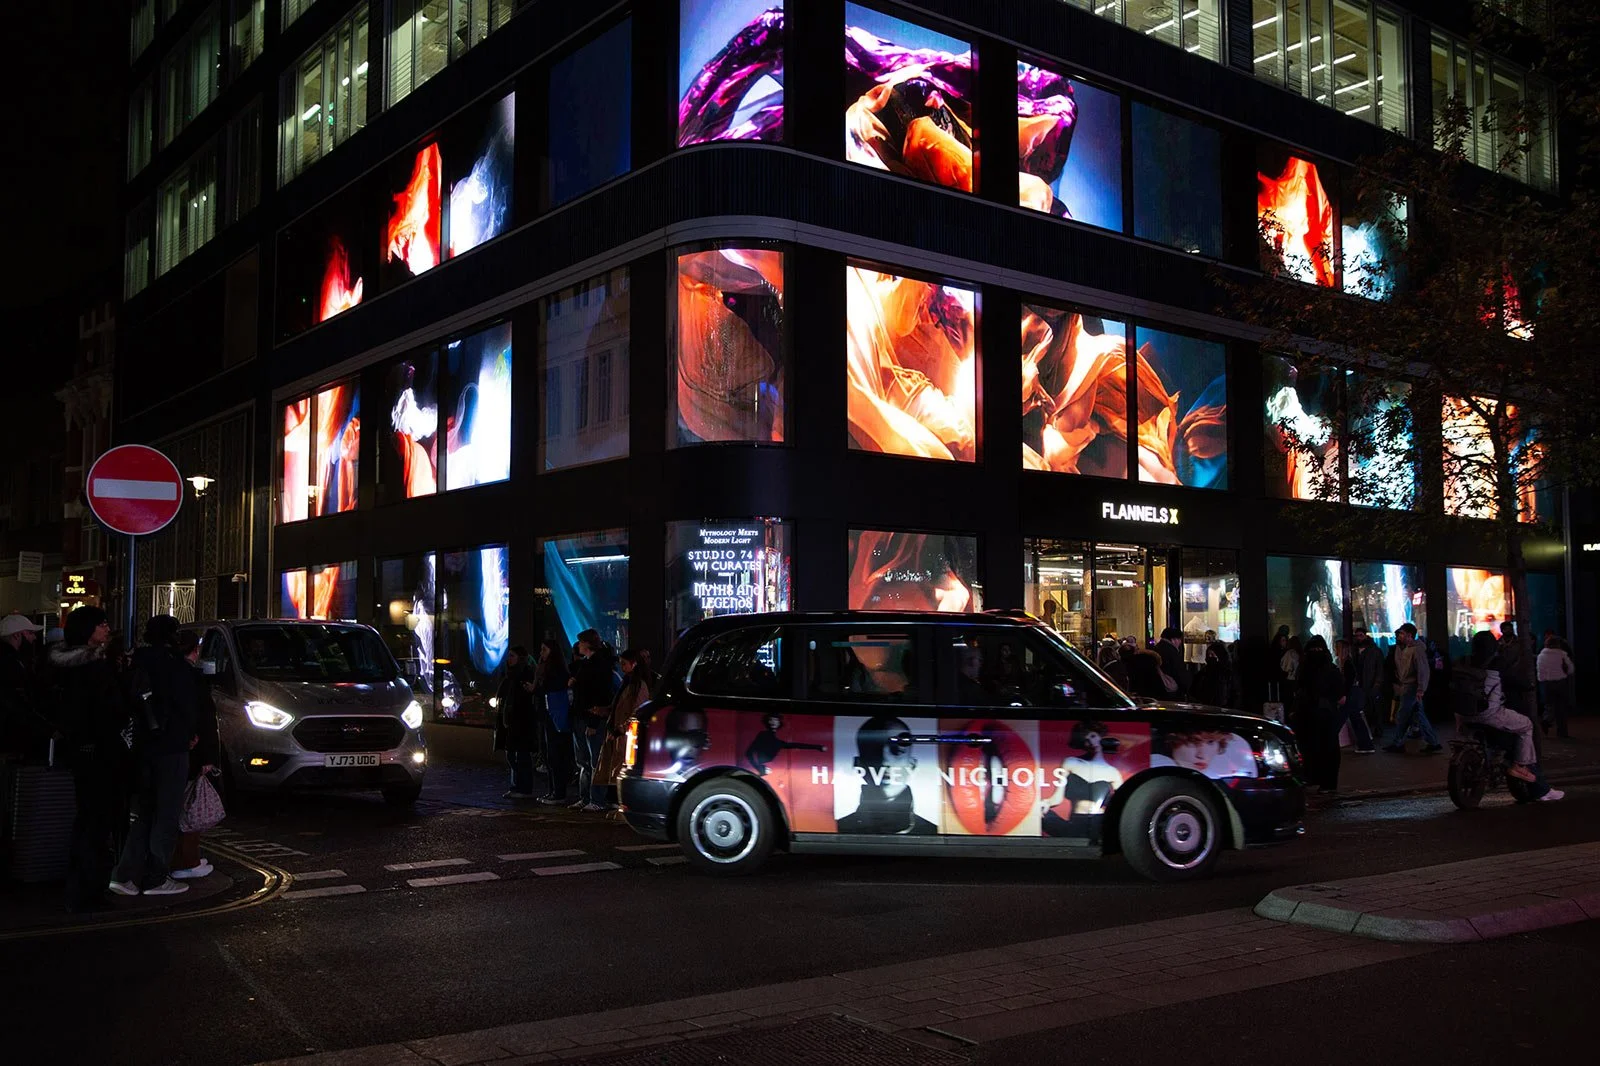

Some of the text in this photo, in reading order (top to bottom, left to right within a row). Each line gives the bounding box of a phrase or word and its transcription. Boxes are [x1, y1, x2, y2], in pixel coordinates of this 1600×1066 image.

[1102, 502, 1168, 523] FLANNELS
[688, 550, 735, 560] STUDIO
[740, 550, 753, 559] 74
[711, 561, 761, 571] CURATES
[694, 582, 733, 598] MYTHS
[701, 596, 753, 610] LEGENDS
[329, 755, 376, 765] YJ73 UDG
[812, 766, 1068, 788] HRVEY NICHOLS
